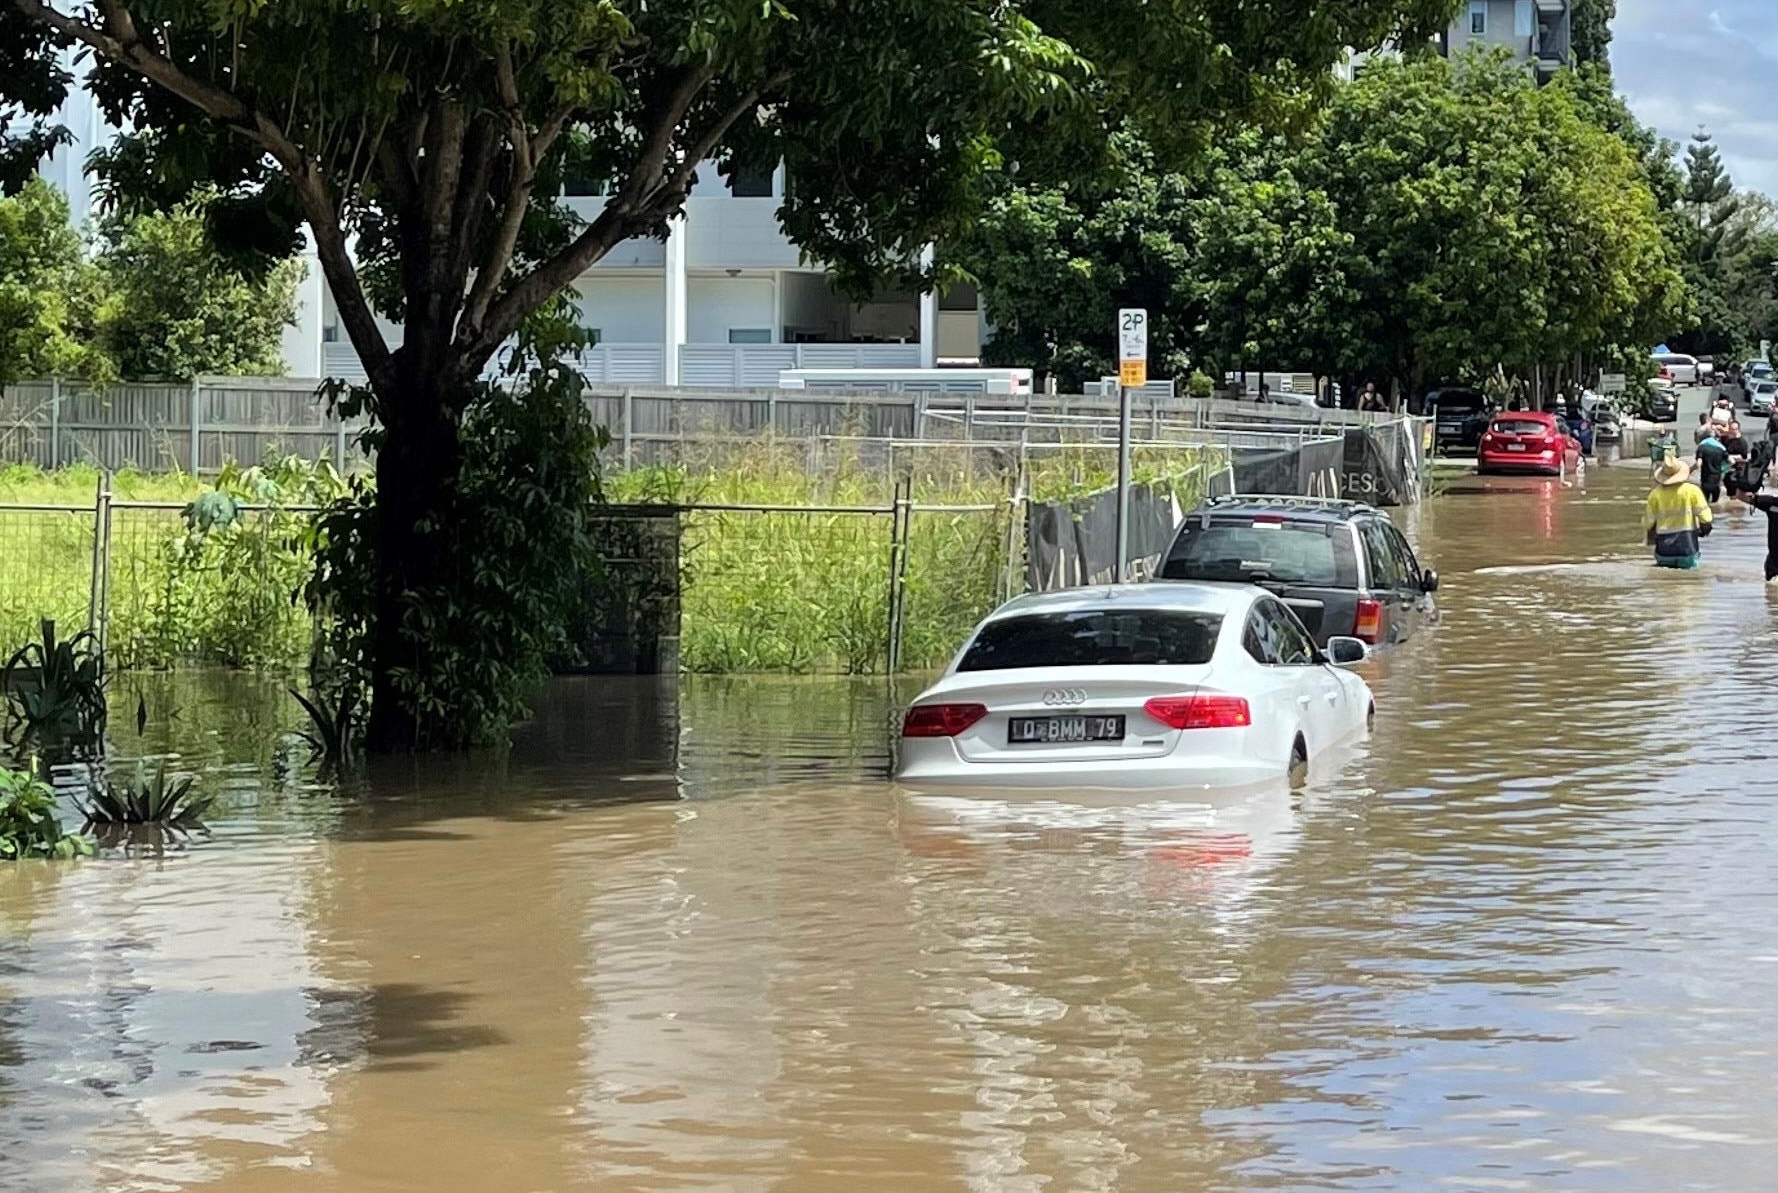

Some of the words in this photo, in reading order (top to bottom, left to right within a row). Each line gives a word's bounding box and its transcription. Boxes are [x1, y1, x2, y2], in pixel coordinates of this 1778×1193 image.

[1122, 313, 1143, 331] 2P
[1048, 719, 1086, 738] BMM
[1096, 718, 1116, 737] 79
